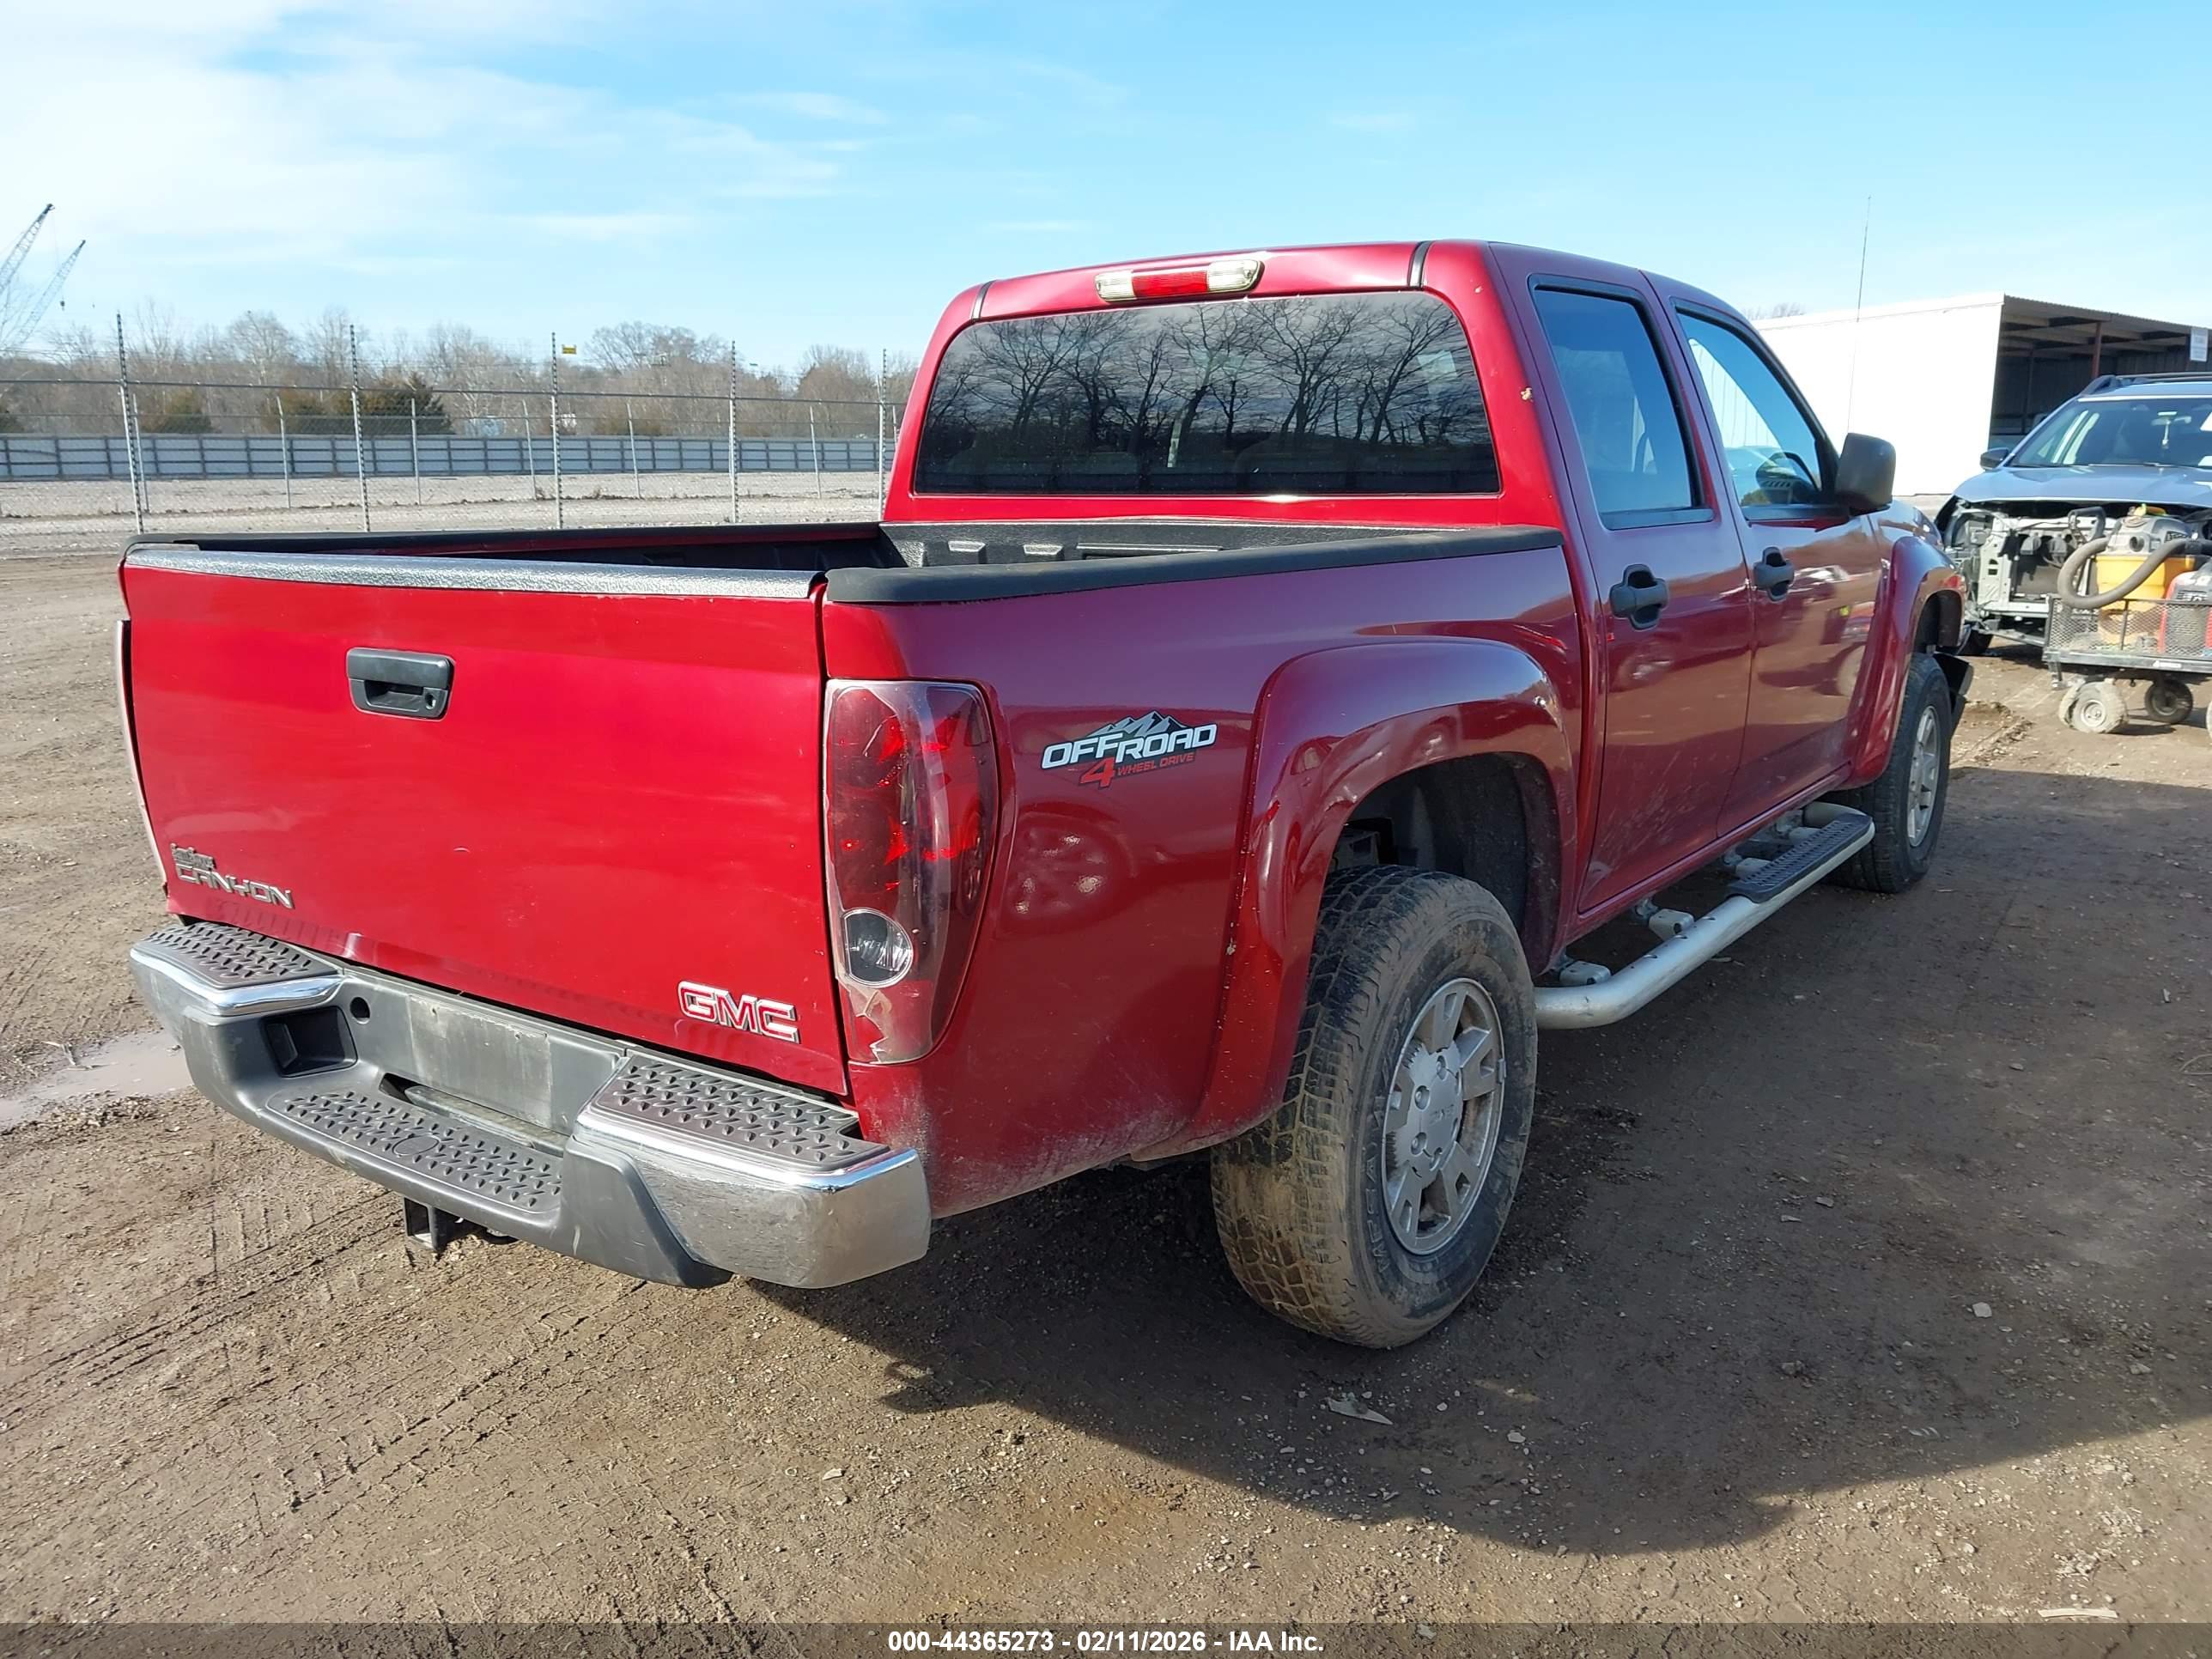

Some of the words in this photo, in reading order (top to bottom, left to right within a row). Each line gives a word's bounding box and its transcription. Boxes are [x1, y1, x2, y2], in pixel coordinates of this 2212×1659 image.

[1079, 757, 1115, 788] 4
[1118, 763, 1157, 776] WHEEL
[1159, 752, 1195, 769] DRIVE
[177, 864, 294, 908] CANYON
[678, 981, 799, 1044] GMC
